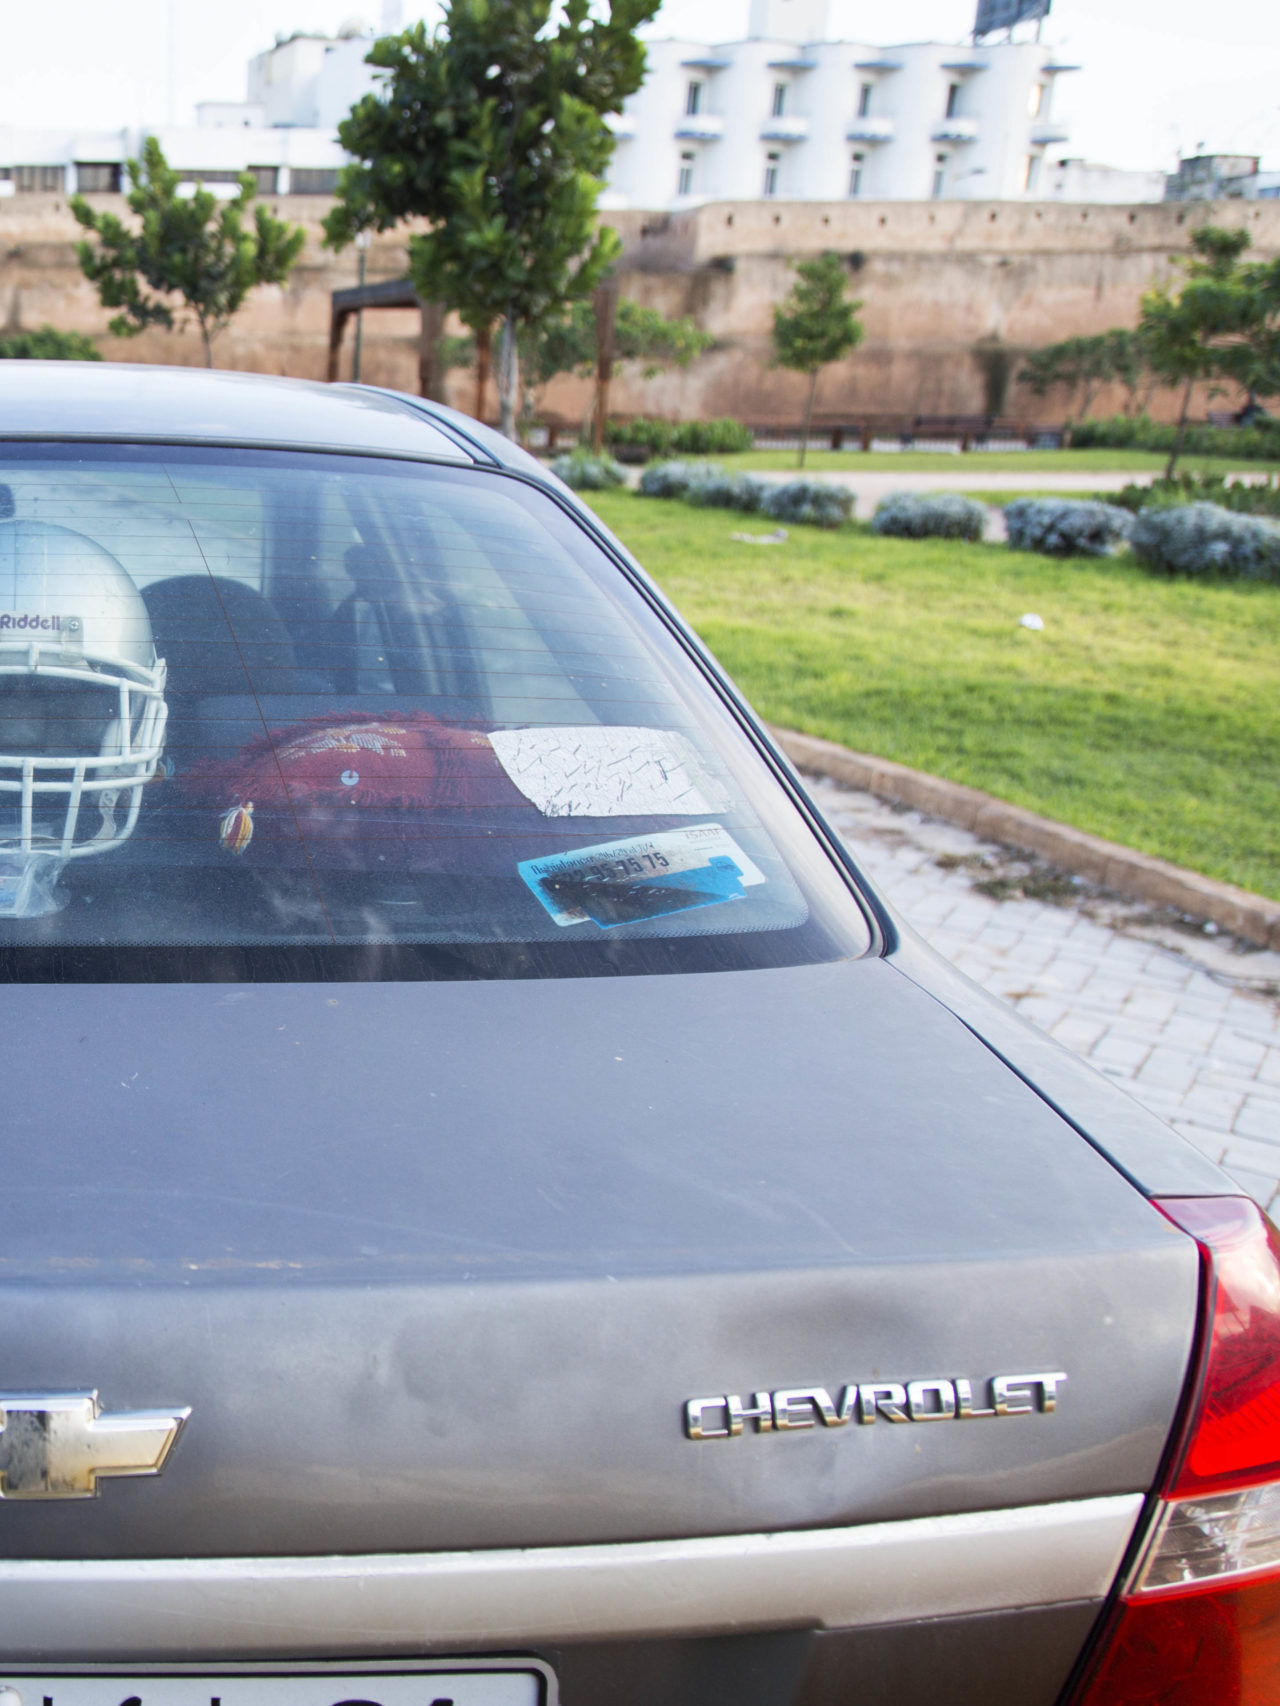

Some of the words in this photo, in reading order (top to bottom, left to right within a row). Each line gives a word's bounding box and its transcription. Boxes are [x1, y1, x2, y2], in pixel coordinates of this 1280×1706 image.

[0, 613, 61, 630] Riddell
[616, 857, 644, 876] 75
[641, 851, 671, 869] 75
[686, 1371, 1068, 1440] CHEVROLET
